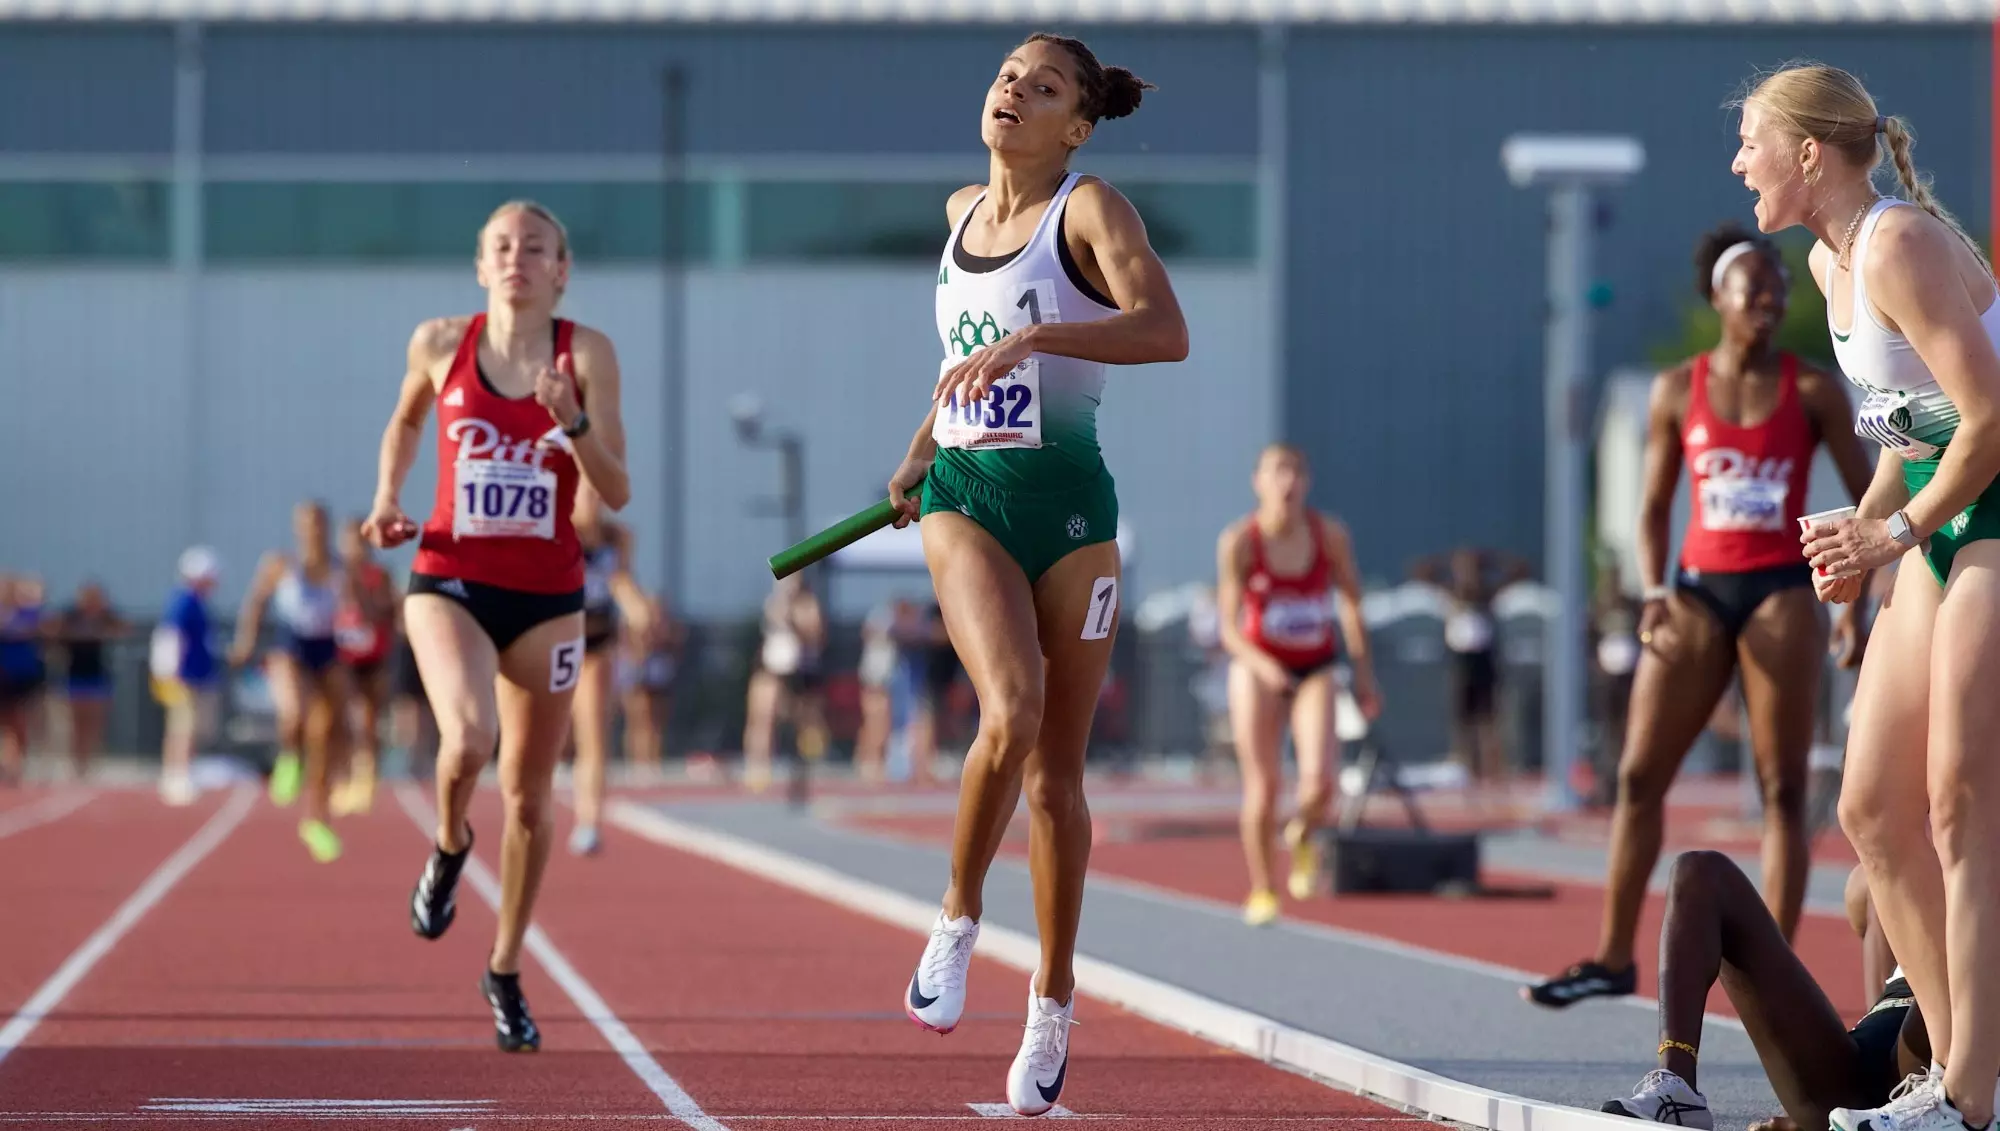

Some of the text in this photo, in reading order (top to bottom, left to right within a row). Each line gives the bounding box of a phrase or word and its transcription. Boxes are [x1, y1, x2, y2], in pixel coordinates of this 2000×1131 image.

[948, 384, 1033, 429] 1032
[446, 417, 545, 473] Pitt
[462, 482, 549, 519] 1078
[1094, 583, 1115, 634] 1
[554, 646, 575, 687] 5
